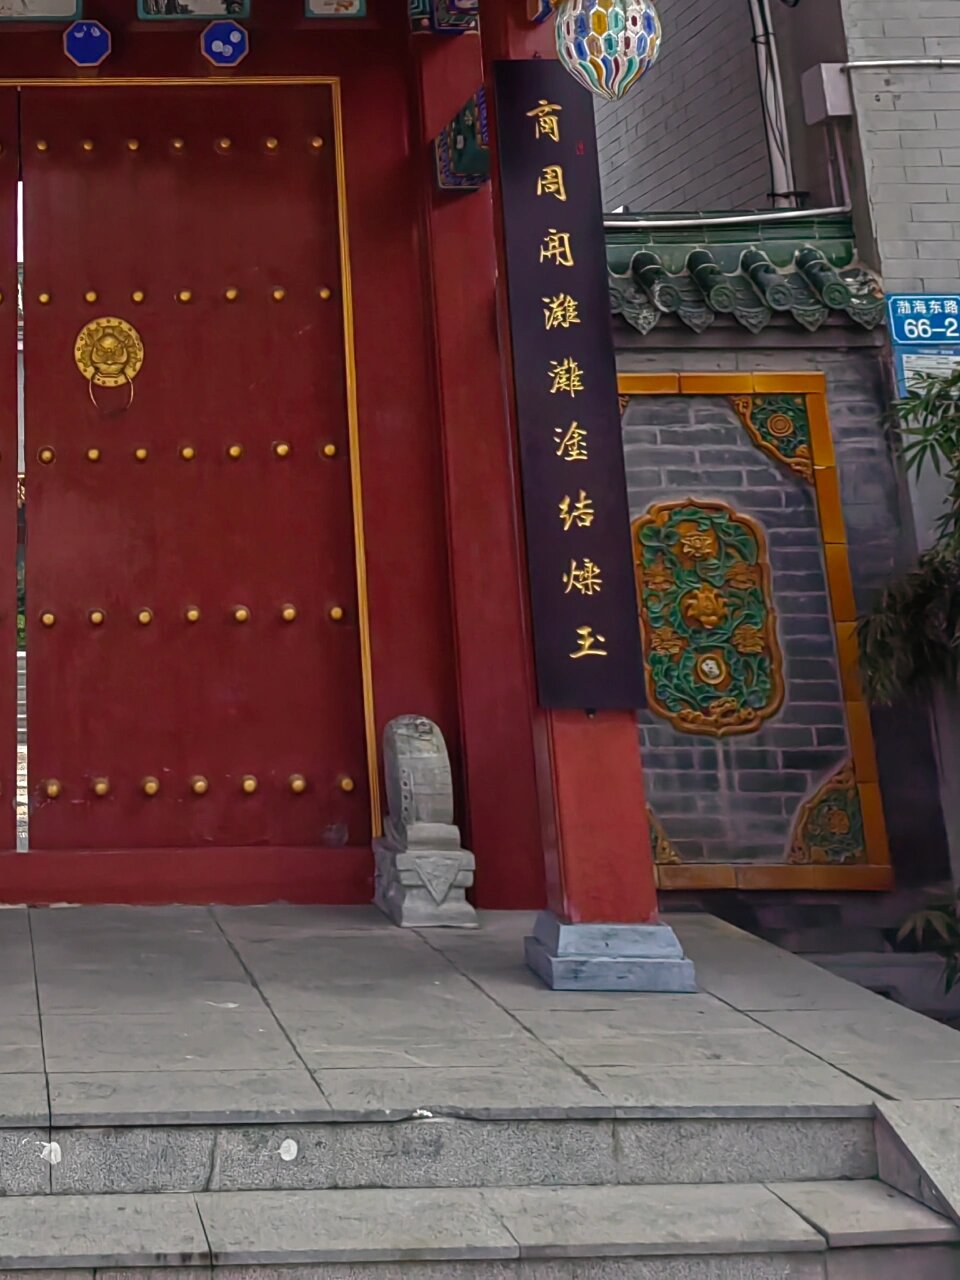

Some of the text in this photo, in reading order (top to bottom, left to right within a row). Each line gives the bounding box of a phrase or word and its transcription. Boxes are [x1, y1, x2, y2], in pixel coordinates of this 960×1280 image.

[896, 300, 959, 315] 渤海东路
[903, 317, 960, 338] 66-2
